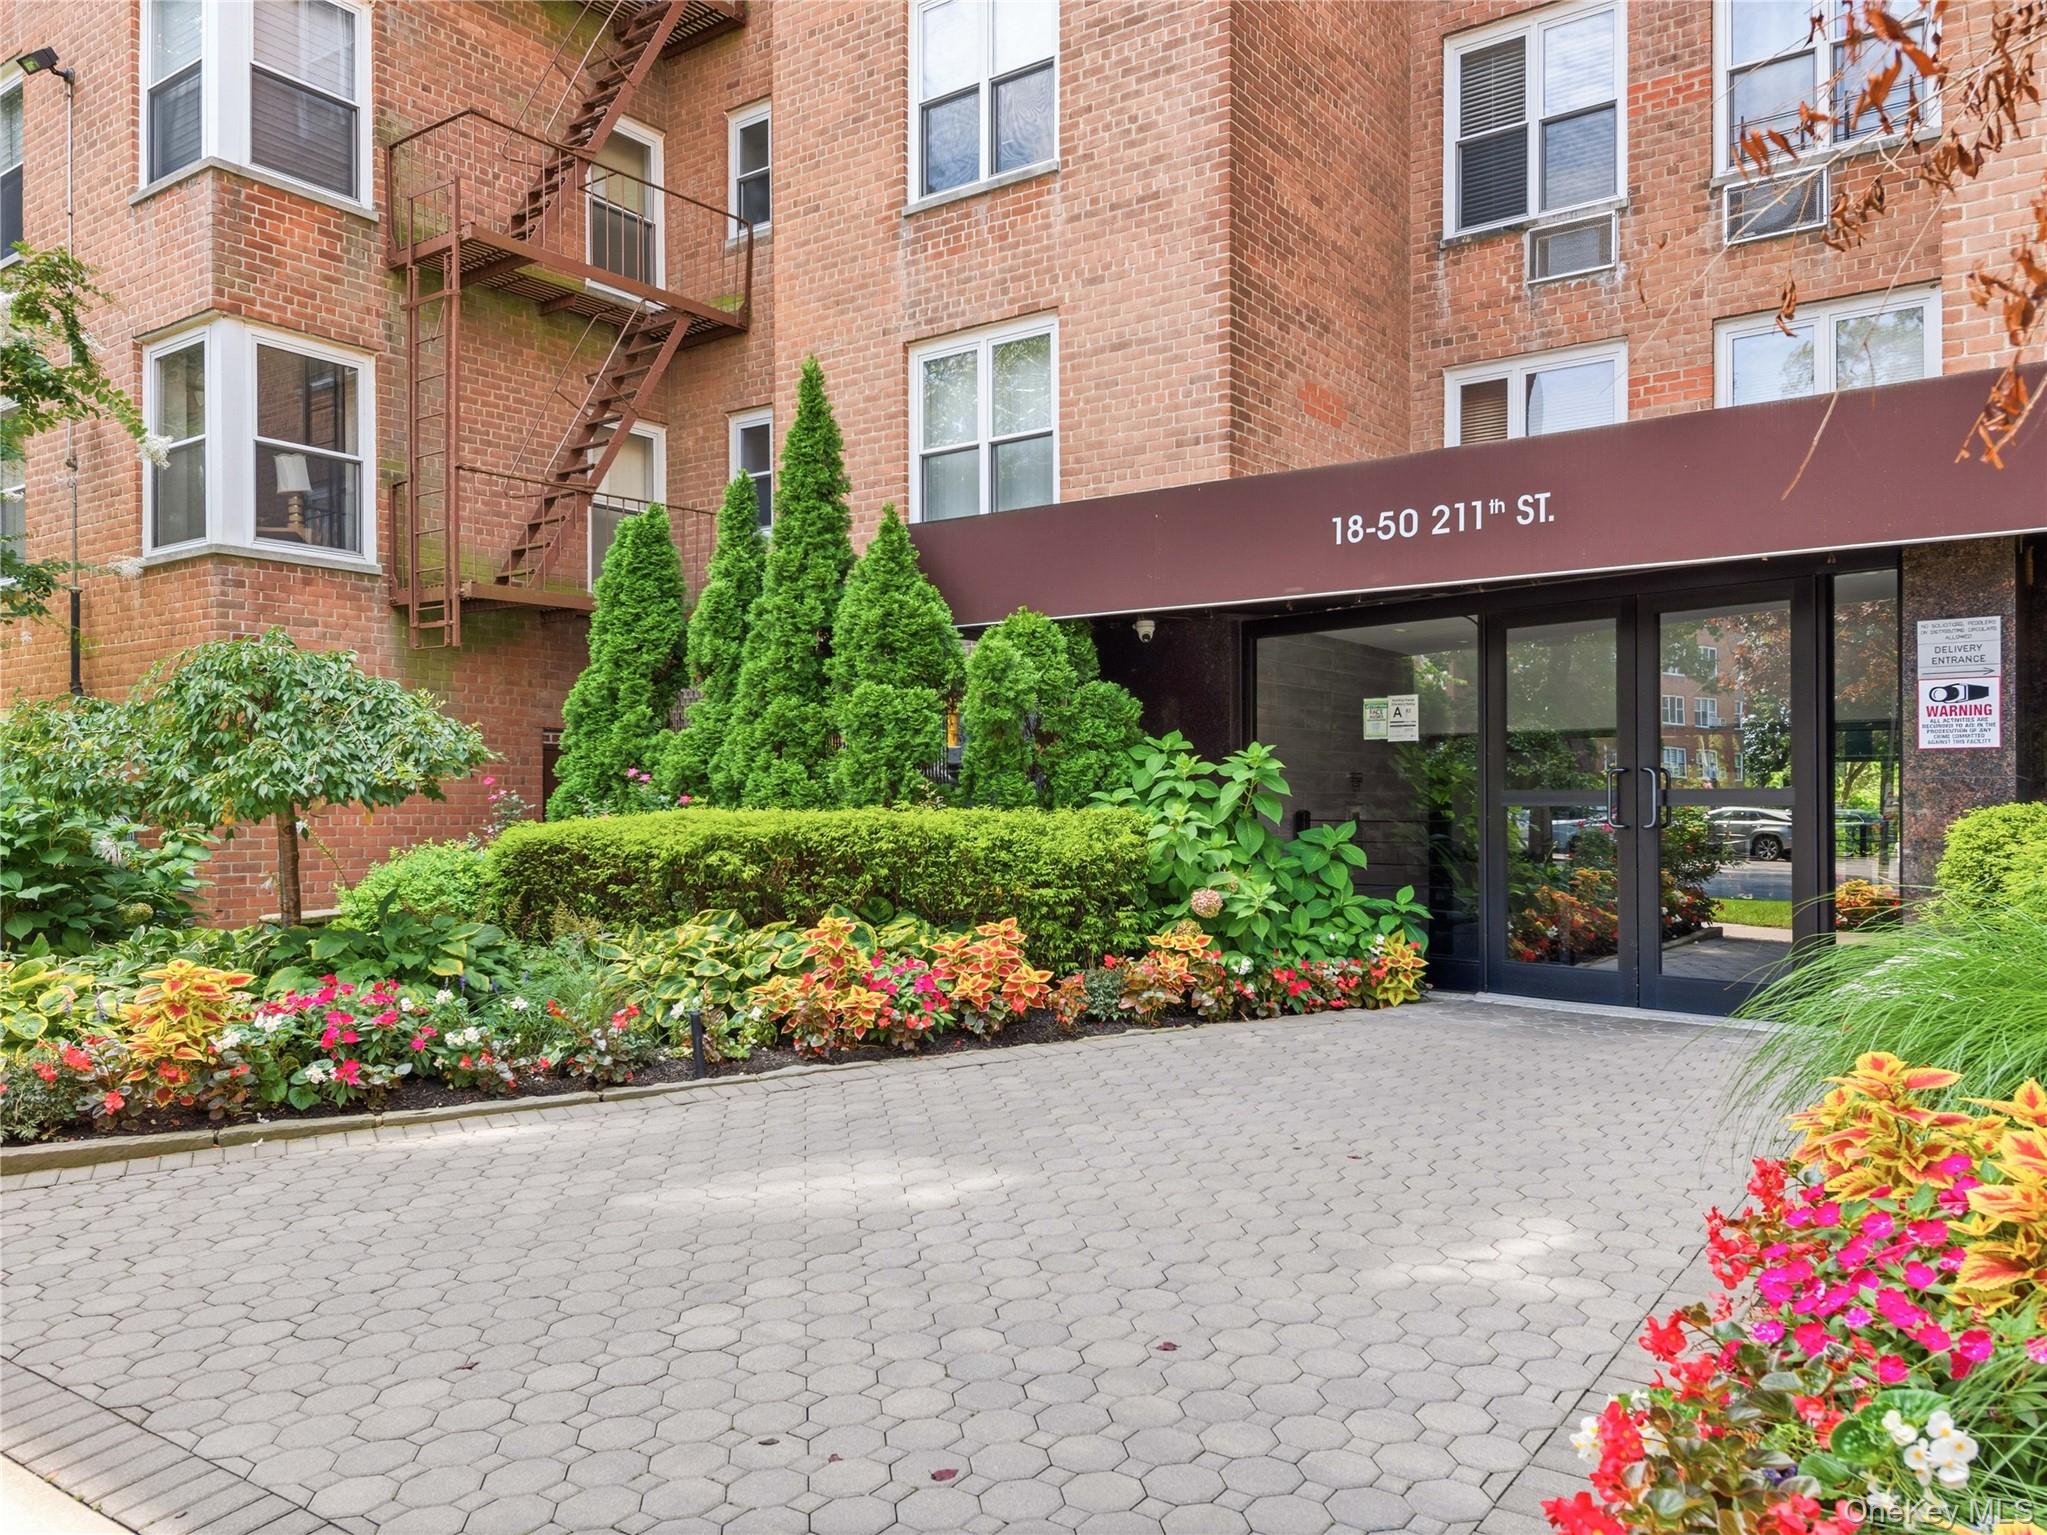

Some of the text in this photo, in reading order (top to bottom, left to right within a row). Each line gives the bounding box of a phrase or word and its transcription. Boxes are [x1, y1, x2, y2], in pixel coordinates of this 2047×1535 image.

[1332, 508, 1419, 545] 18-50
[1516, 491, 1555, 526] ST.
[1934, 643, 1983, 654] DELIVERY
[1931, 654, 1987, 665] ENTRANCE
[1393, 706, 1402, 718] A
[1926, 703, 1993, 717] WARNING
